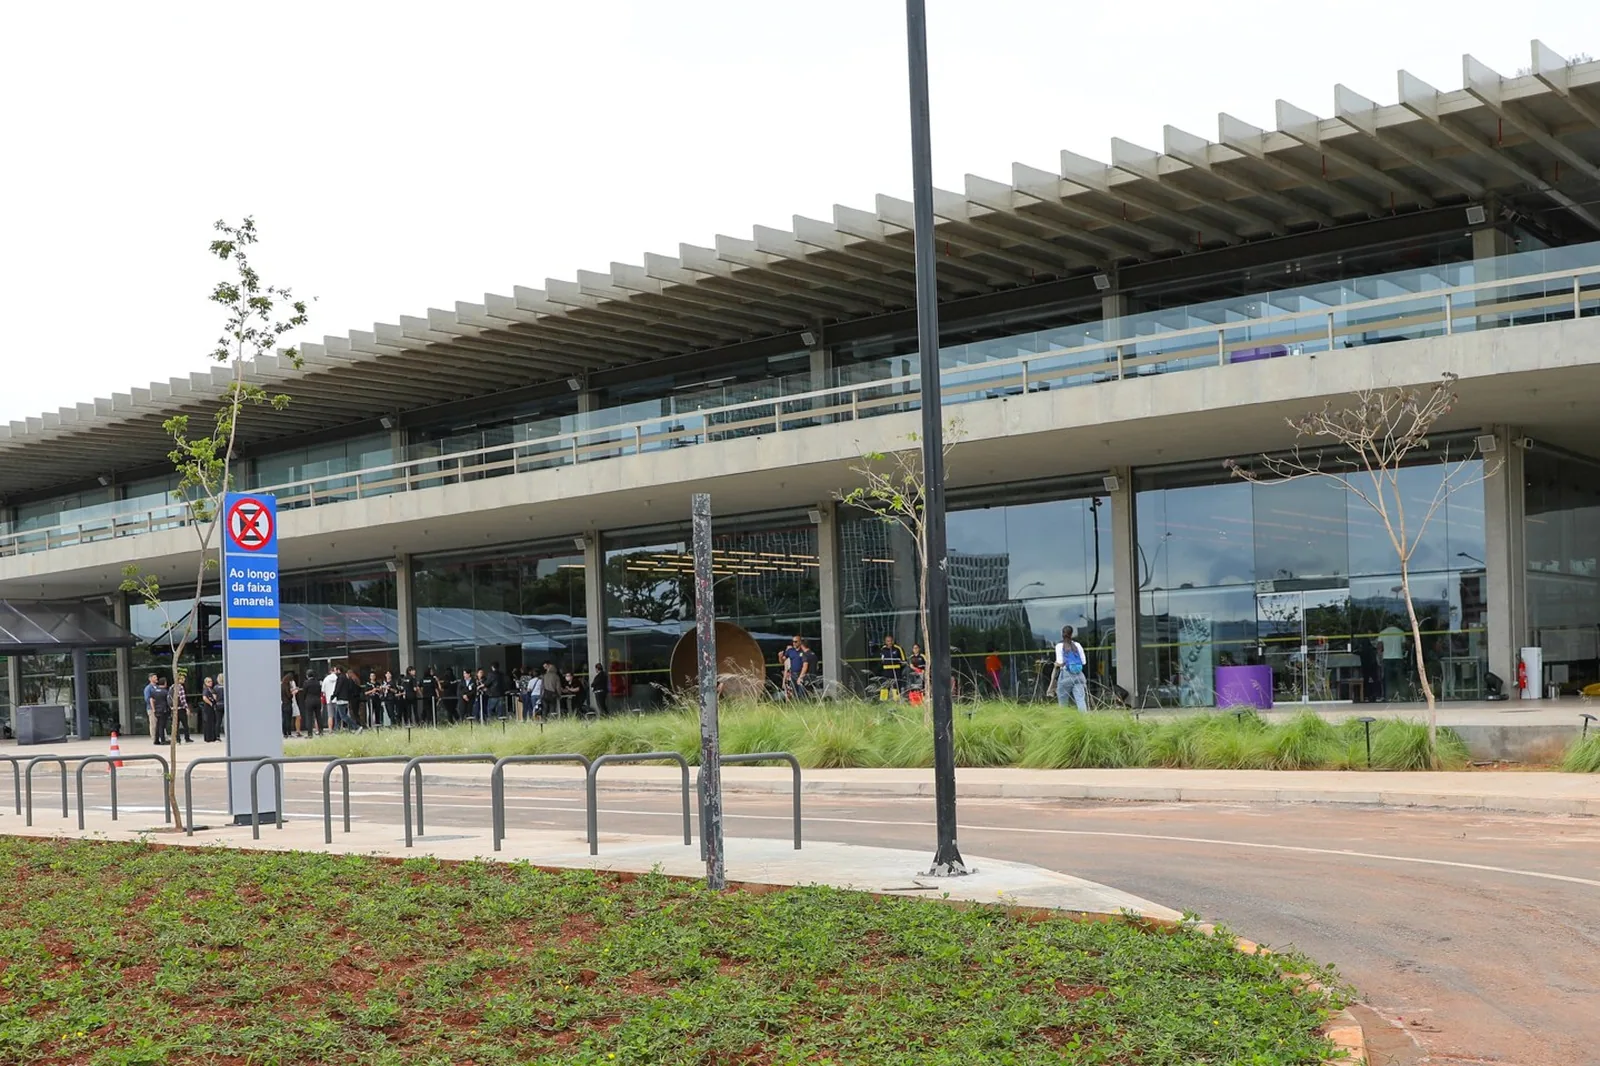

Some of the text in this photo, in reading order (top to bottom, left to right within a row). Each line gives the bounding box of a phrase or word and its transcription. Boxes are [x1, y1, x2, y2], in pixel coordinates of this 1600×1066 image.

[229, 568, 276, 581] Ao longo
[231, 582, 272, 593] da faixa
[233, 596, 274, 606] amarela
